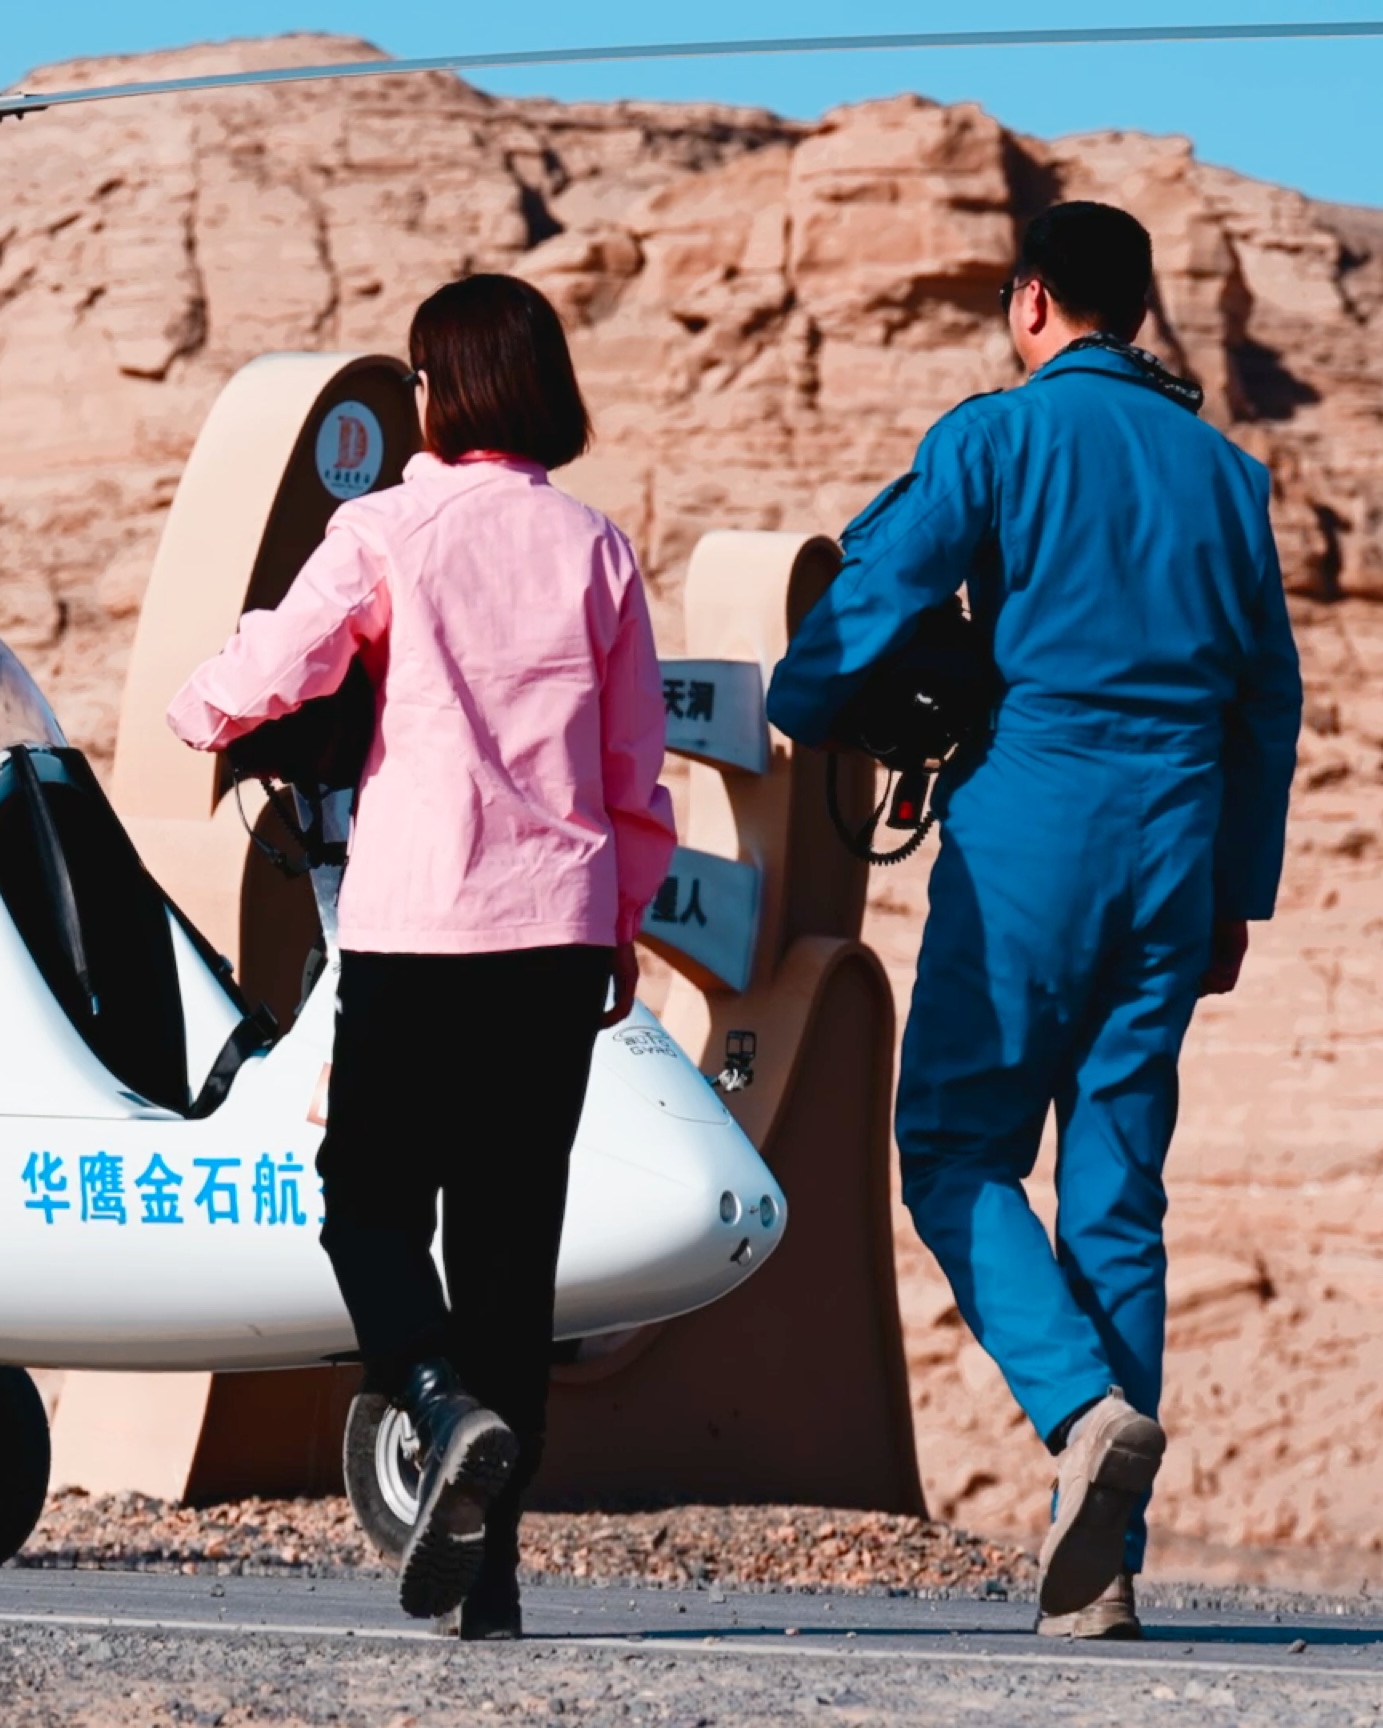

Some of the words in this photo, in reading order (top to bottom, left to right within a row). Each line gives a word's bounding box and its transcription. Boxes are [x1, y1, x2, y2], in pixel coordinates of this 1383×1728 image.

[21, 1152, 325, 1226] 华鹰金石航
